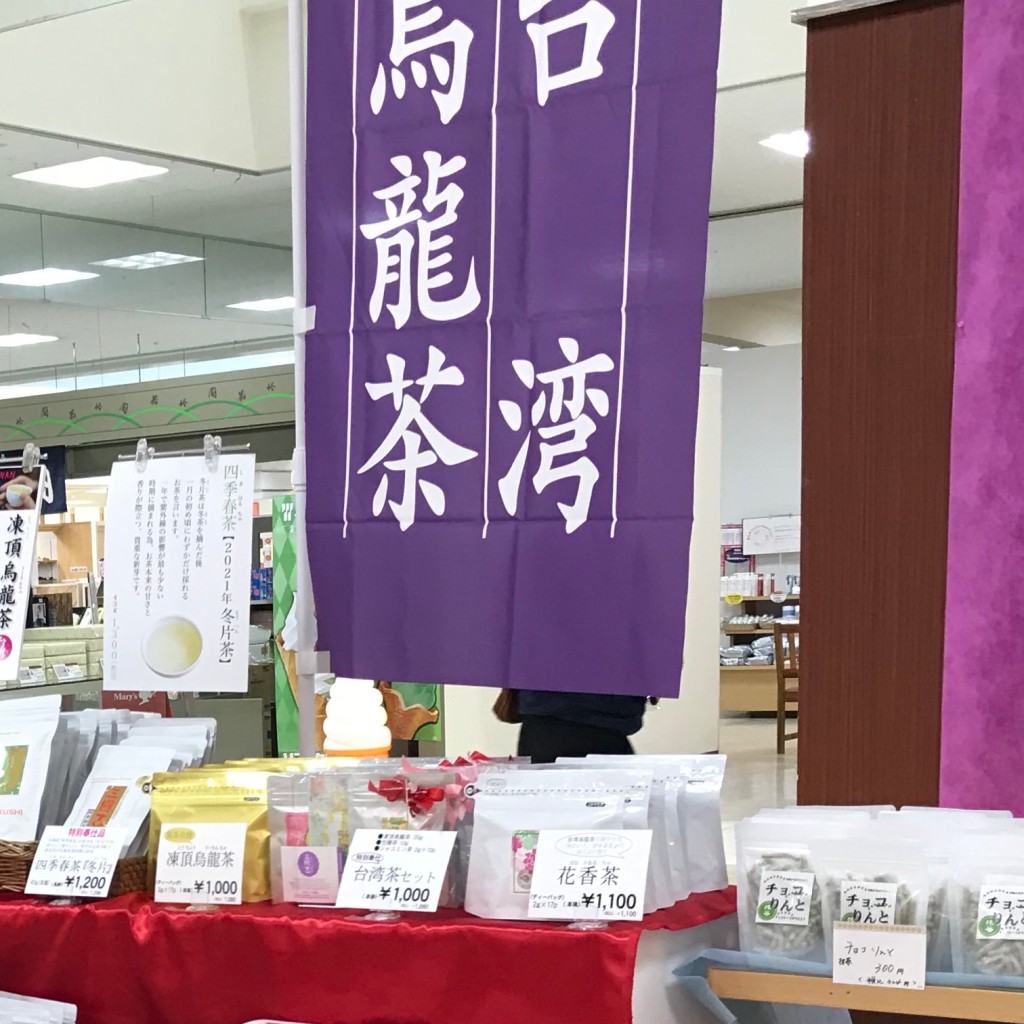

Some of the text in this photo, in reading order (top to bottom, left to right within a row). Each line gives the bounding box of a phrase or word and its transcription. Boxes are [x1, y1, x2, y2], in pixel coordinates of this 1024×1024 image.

[113, 693, 138, 701] Mary's
[167, 851, 235, 867] 凍頂烏龍茶
[354, 865, 435, 883] 台湾茶セット
[557, 865, 621, 886] 花香茶
[65, 875, 106, 889] ¥1,200
[194, 880, 237, 895] ¥1,000
[379, 886, 430, 903] ¥1,000
[765, 883, 805, 896] チョコ
[582, 893, 637, 910] ¥1,100
[771, 898, 805, 911] りんと
[845, 893, 892, 907] チョコ
[852, 911, 889, 924] りんと
